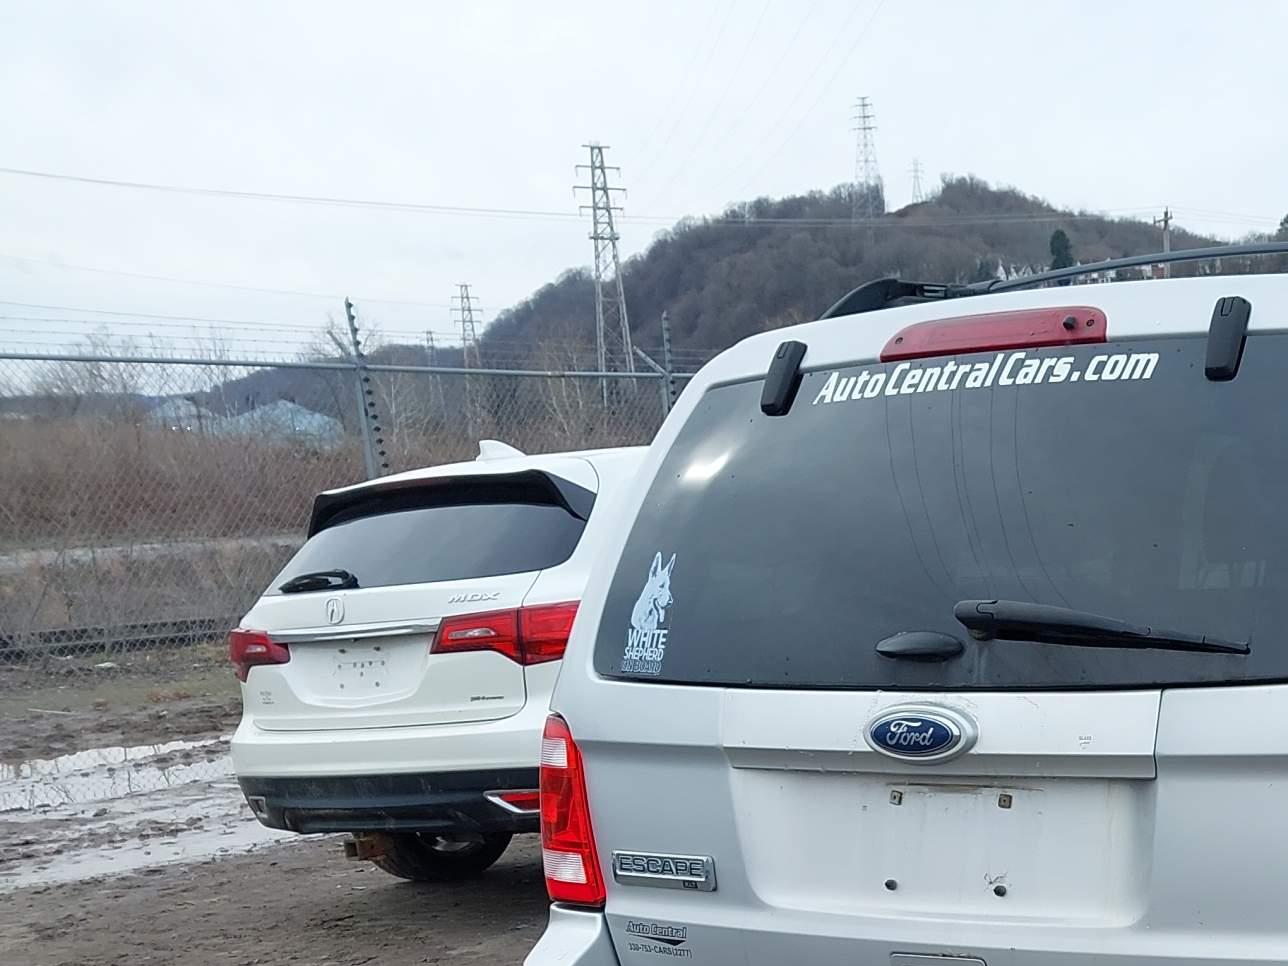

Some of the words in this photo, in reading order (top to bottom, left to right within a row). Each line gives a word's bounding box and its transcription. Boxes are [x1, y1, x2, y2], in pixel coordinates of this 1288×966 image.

[812, 351, 1160, 406] AutoCentralCars.com
[448, 592, 501, 604] MDX
[628, 628, 668, 648] WHITE
[624, 647, 664, 660] SHEPHERD
[886, 720, 935, 746] Ford
[619, 856, 705, 877] ESCAPE
[625, 920, 650, 935] Auto
[650, 923, 687, 939] Central
